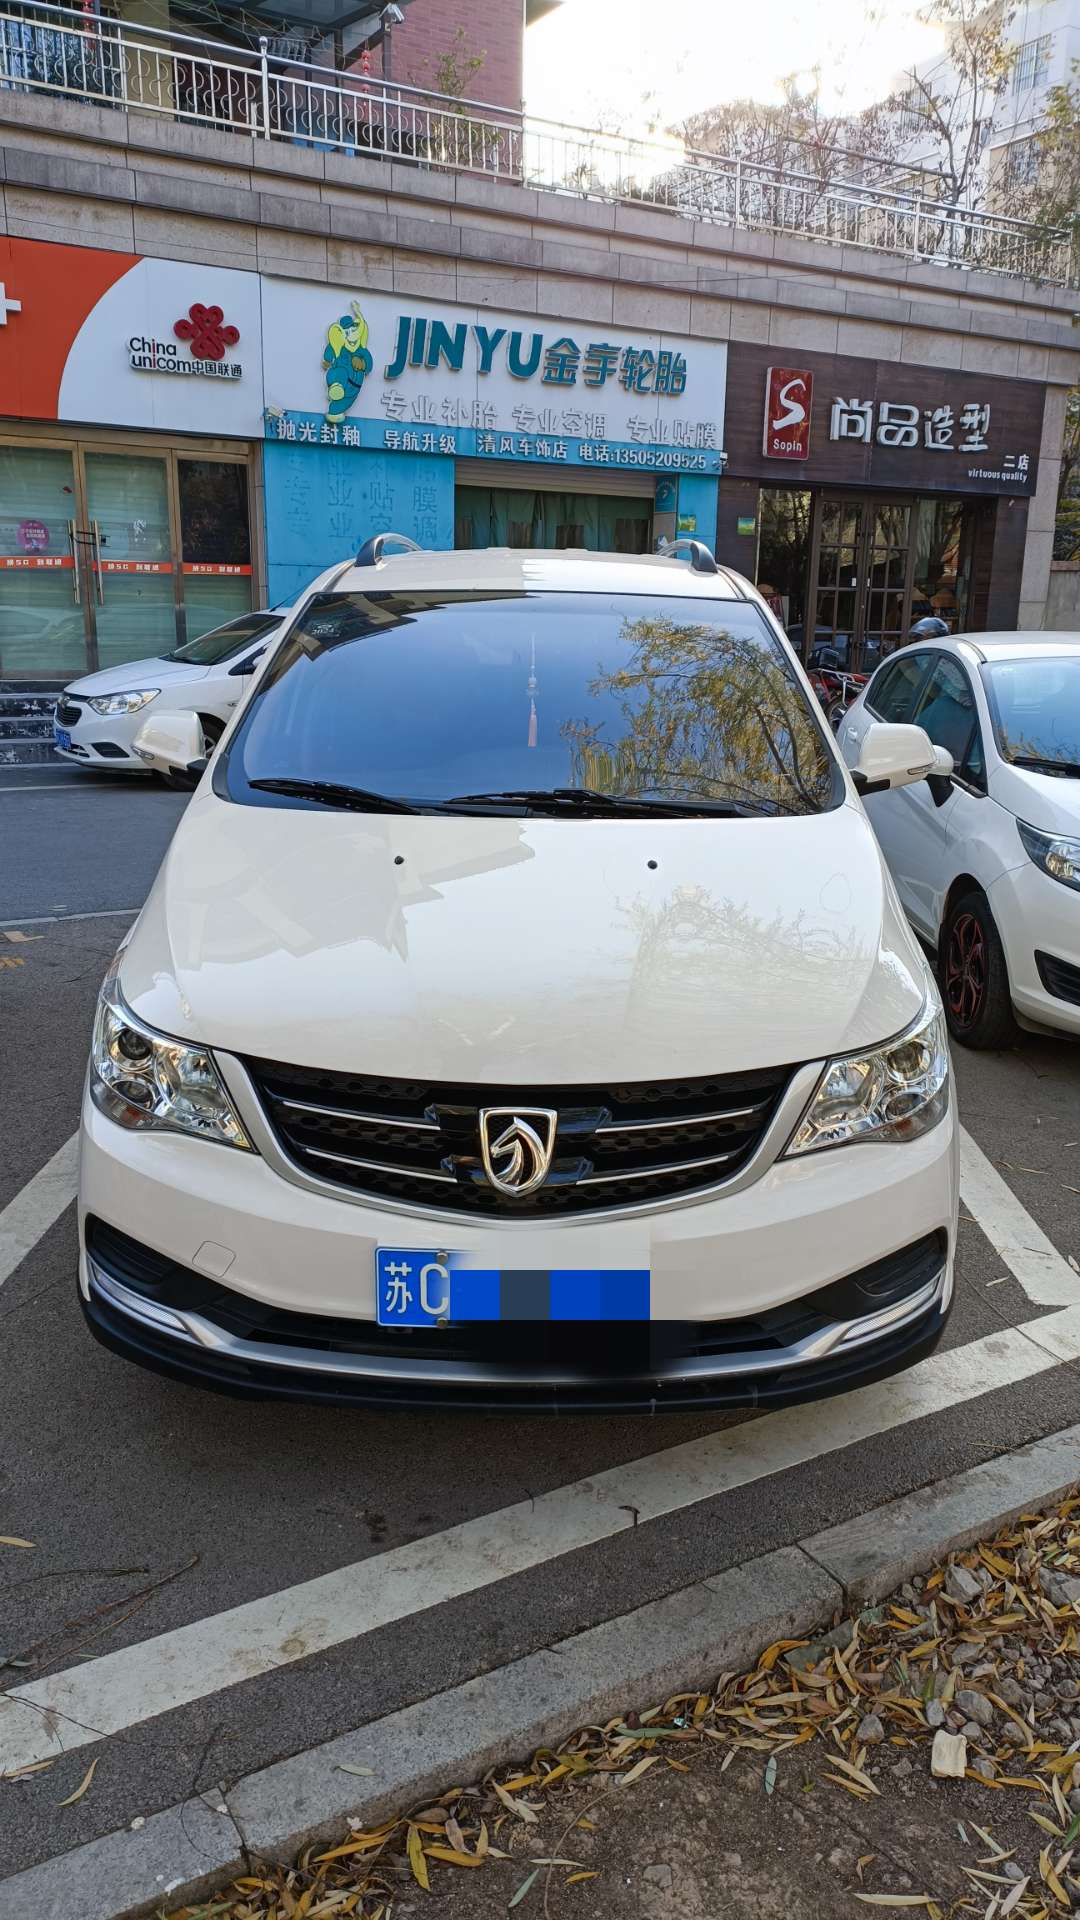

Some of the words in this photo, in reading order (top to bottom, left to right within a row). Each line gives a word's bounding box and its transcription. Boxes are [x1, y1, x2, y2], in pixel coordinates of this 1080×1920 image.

[129, 336, 177, 356] China
[384, 315, 544, 380] JINYU
[541, 336, 688, 396] 金宇轮胎
[131, 354, 191, 373] unicom
[191, 359, 243, 378] 中国联通
[380, 388, 498, 431] 专业补胎
[511, 402, 609, 440] 专业空调
[626, 413, 719, 450] 专业贴膜
[829, 396, 991, 452] 尚品造型
[276, 419, 361, 447] 抛光封釉
[383, 429, 457, 455] 导航升级
[477, 433, 570, 460] 清风车饰店
[578, 443, 707, 470] 电话:13505209525
[773, 438, 803, 452] Sopin
[1002, 453, 1030, 472] 二店
[968, 468, 1000, 480] virtuous
[1001, 471, 1029, 484] quality
